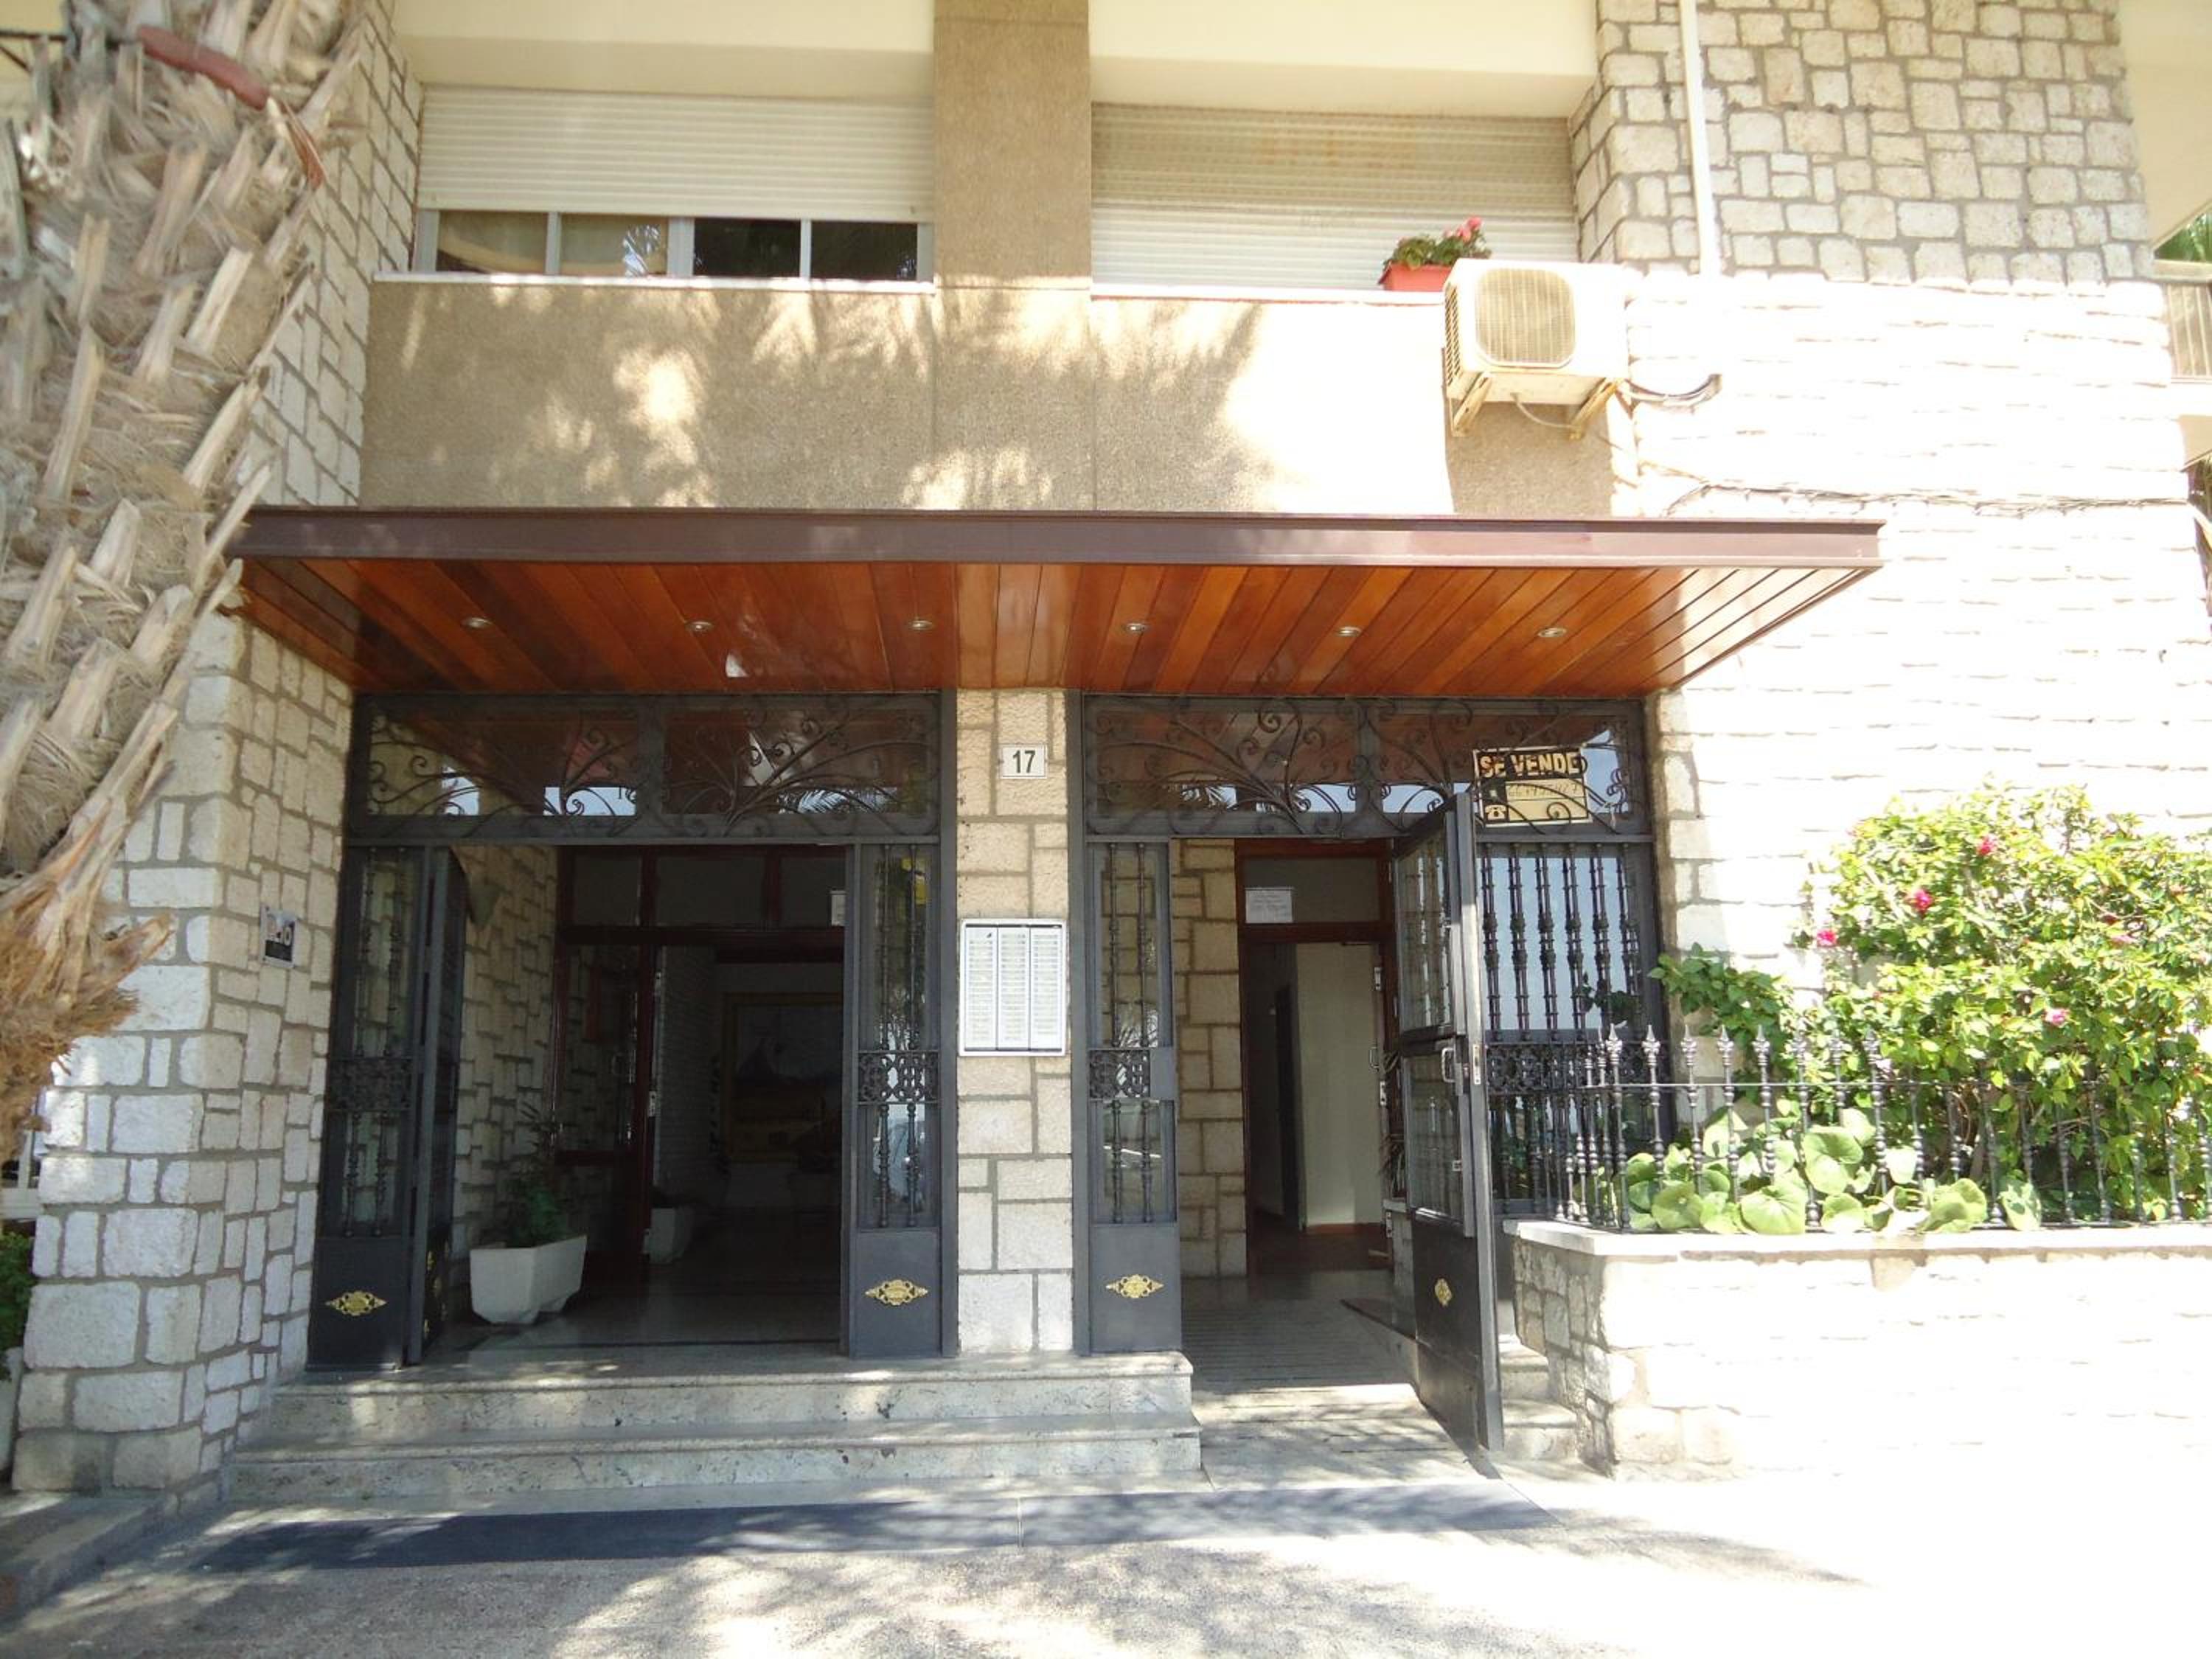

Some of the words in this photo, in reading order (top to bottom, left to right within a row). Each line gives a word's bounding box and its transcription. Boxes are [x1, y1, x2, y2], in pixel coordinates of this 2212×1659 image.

[1012, 750, 1036, 773] 17
[1479, 754, 1506, 778] SE
[1511, 751, 1580, 776] VENDE
